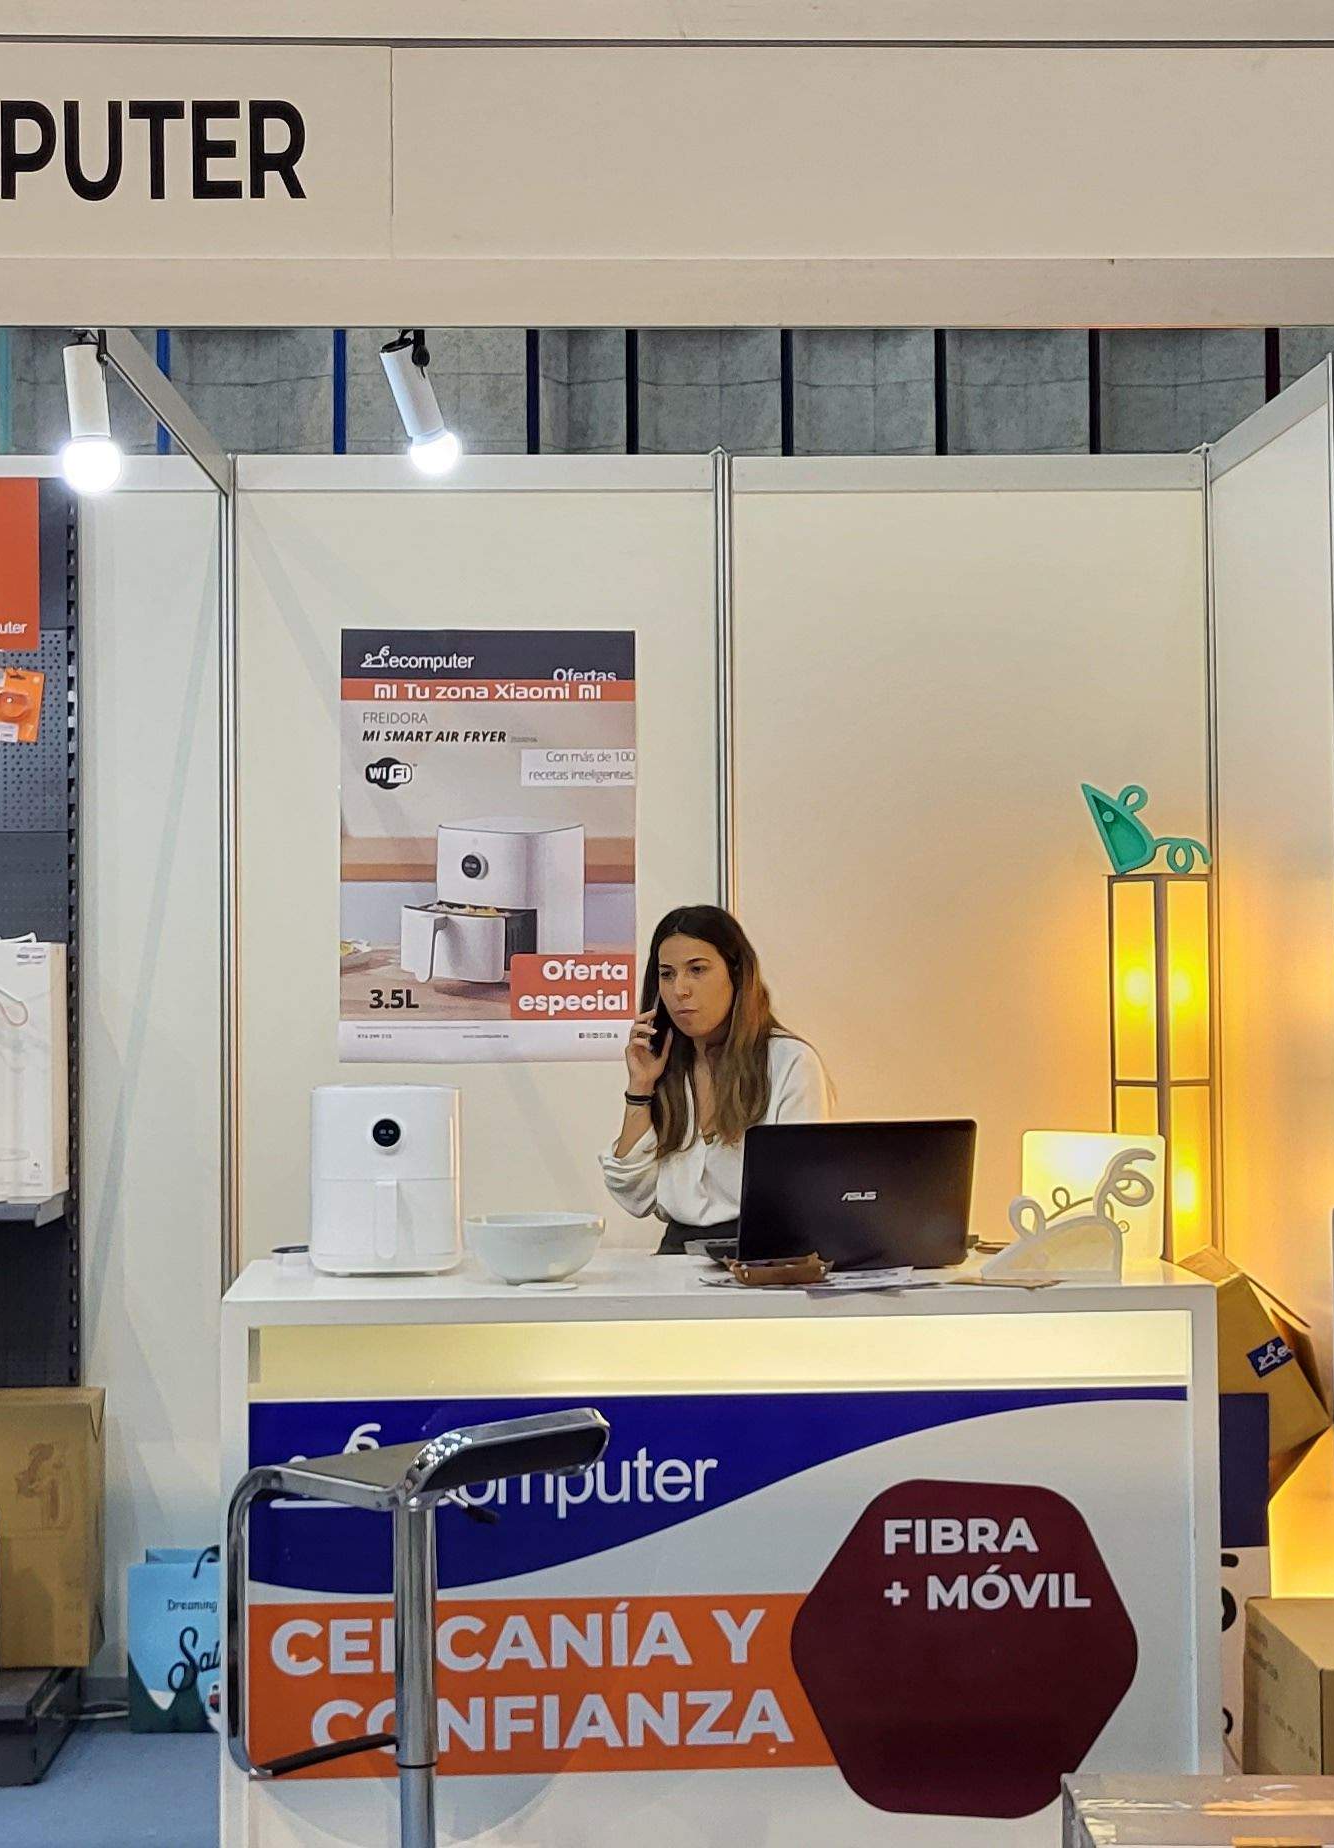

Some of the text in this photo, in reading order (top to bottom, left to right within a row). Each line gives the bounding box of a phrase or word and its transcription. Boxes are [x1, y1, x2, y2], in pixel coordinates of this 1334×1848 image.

[389, 653, 474, 672] ecomputer
[553, 668, 617, 681] Ofertas
[404, 683, 430, 699] Tu
[435, 686, 489, 699] zona
[495, 683, 569, 699] Xiaomi
[363, 712, 428, 724] FREIDORA
[363, 730, 381, 742] MI
[384, 730, 433, 742] SMART
[435, 730, 460, 742] AIR
[463, 731, 507, 742] FRYER
[546, 751, 568, 763] Con
[597, 751, 611, 763] de
[615, 751, 635, 762] 100
[528, 770, 569, 781] recetas
[542, 960, 628, 980] Oferta
[369, 989, 420, 1009] 3.5L
[518, 989, 628, 1016] especial
[437, 1446, 718, 1519] omputer
[884, 1518, 1039, 1555] FIBRA
[884, 1564, 1092, 1610] + MÓVIL
[270, 1600, 769, 1677] CECANÍA Y
